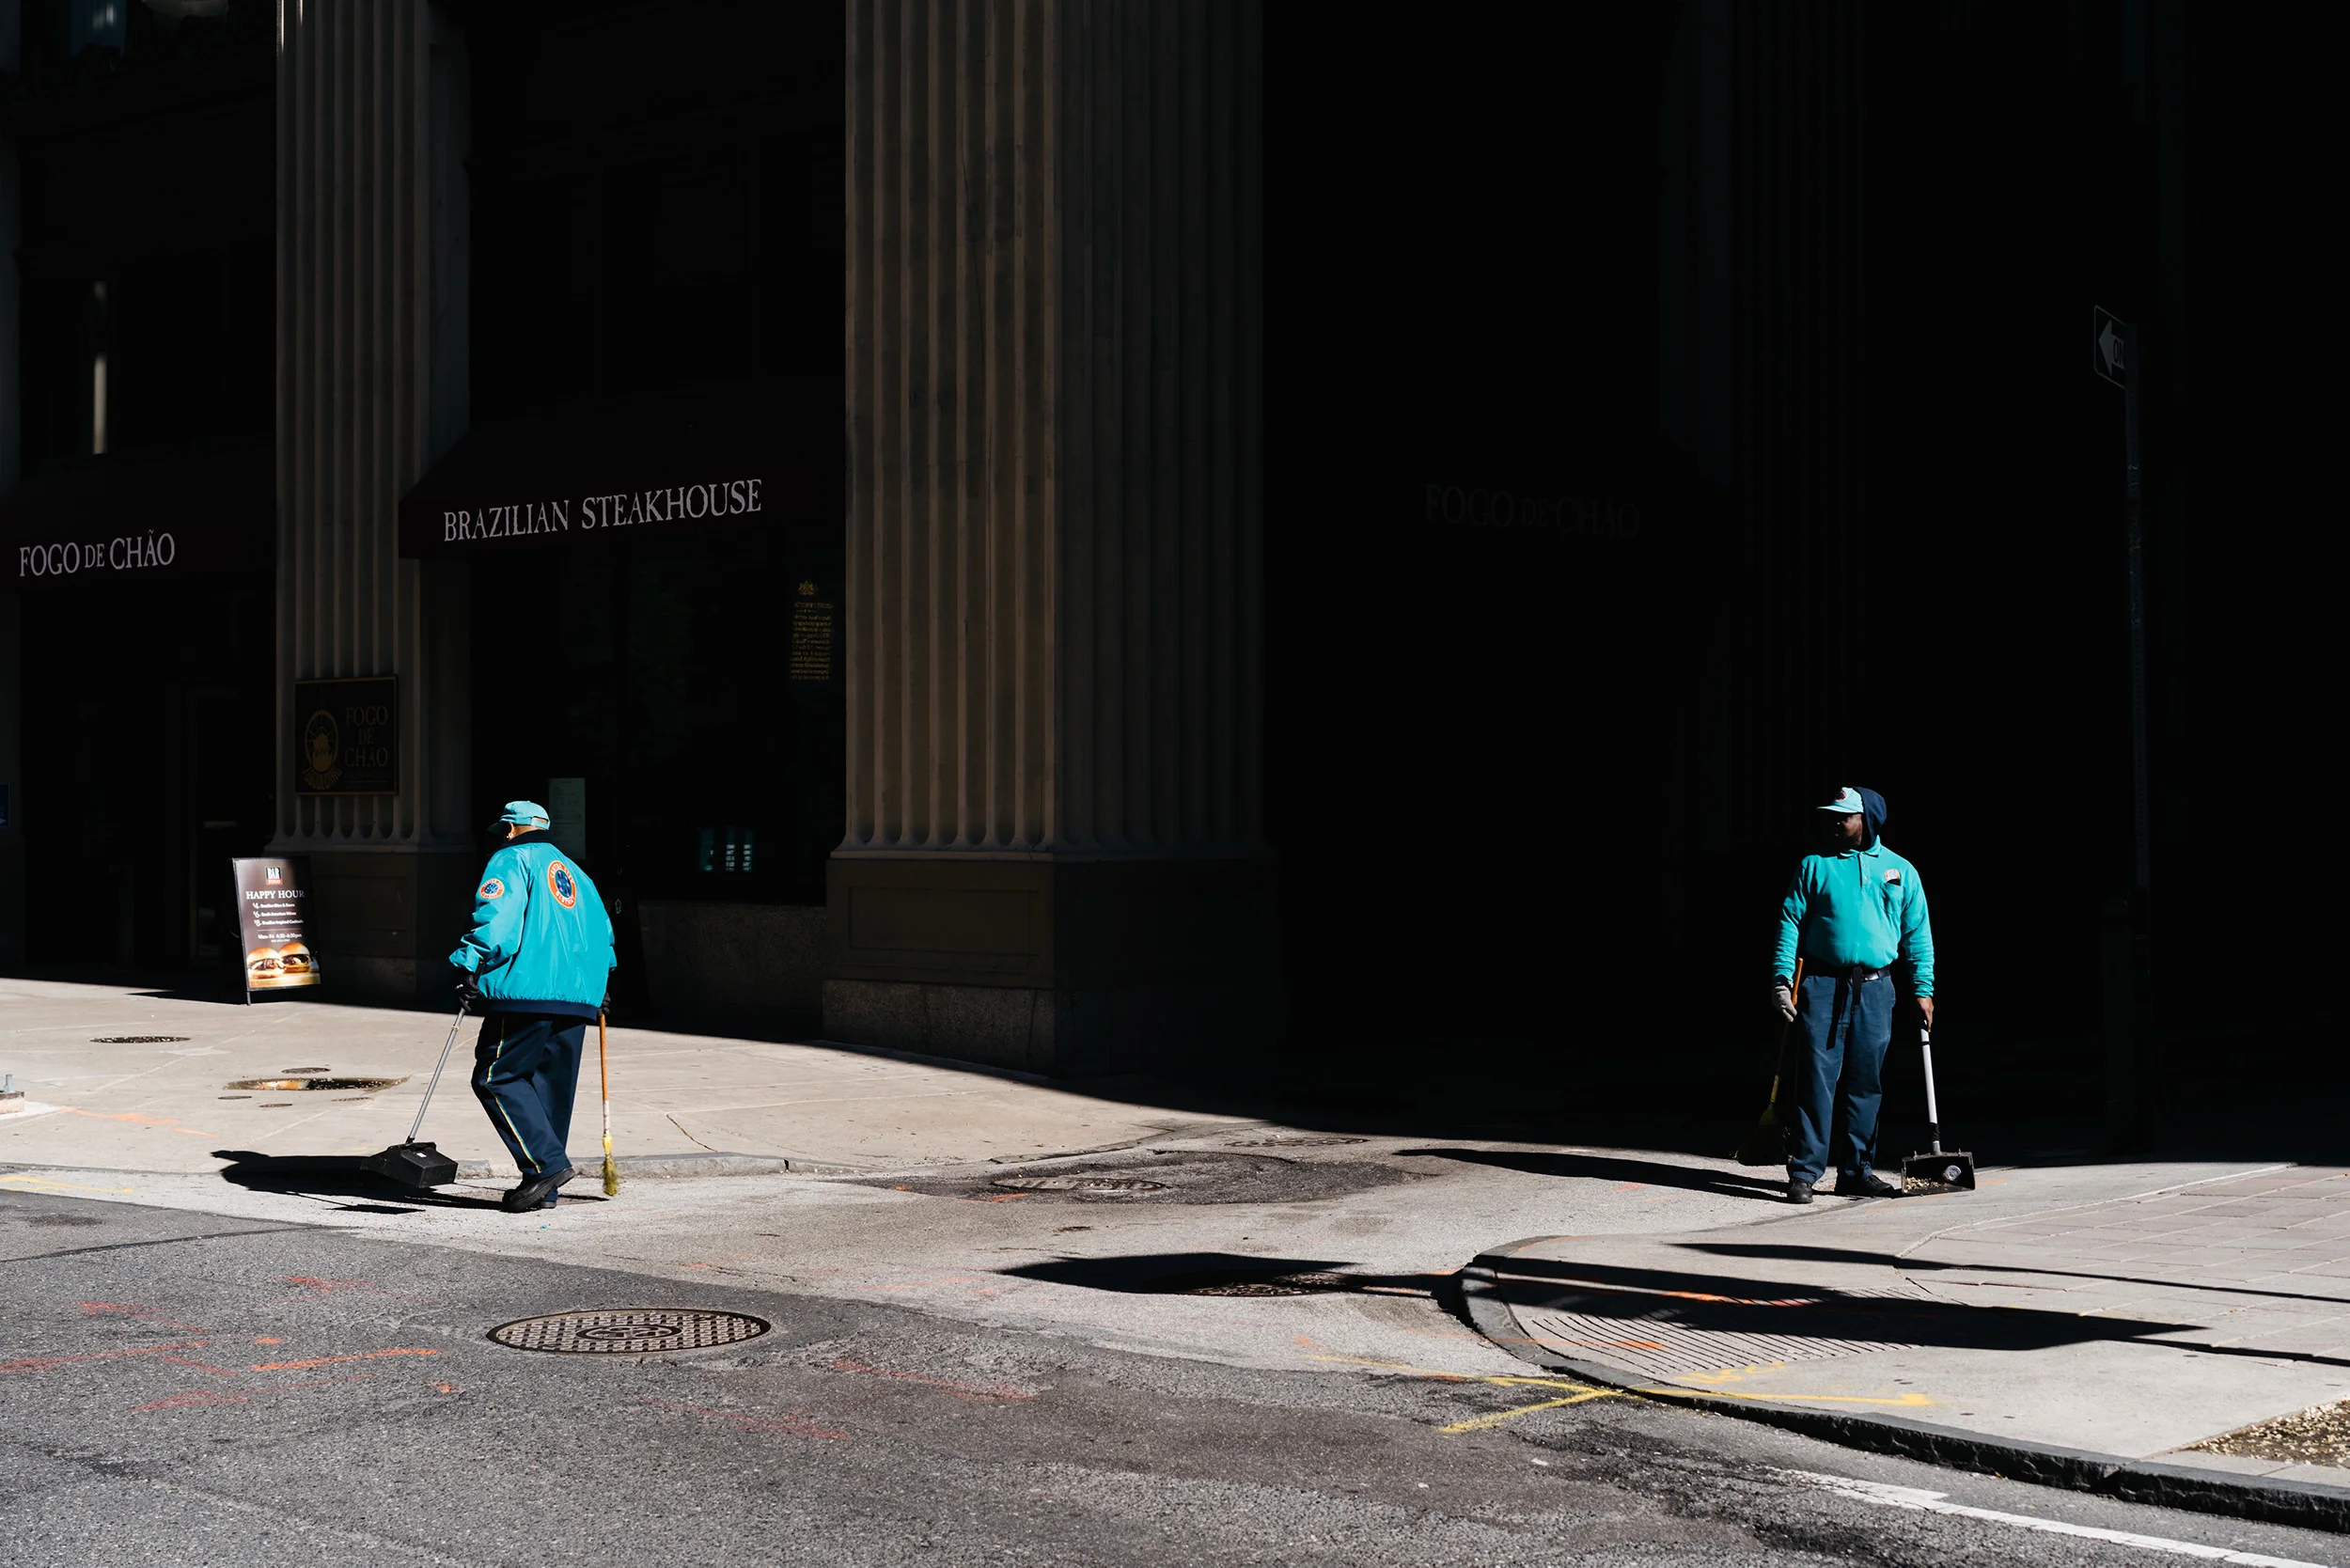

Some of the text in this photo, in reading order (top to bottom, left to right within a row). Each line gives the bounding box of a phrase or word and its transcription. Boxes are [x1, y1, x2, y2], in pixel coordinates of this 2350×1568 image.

[444, 478, 762, 541] BRAZILIAN STEAKHOUSE
[1424, 483, 1514, 528] FOGO
[1521, 496, 1550, 528] DE
[19, 527, 176, 577] FOGO DE CHÃO
[345, 705, 389, 728] FOGO
[357, 728, 375, 745] DE
[267, 867, 280, 879] BAR
[245, 889, 306, 900] HAPPY HOUR
